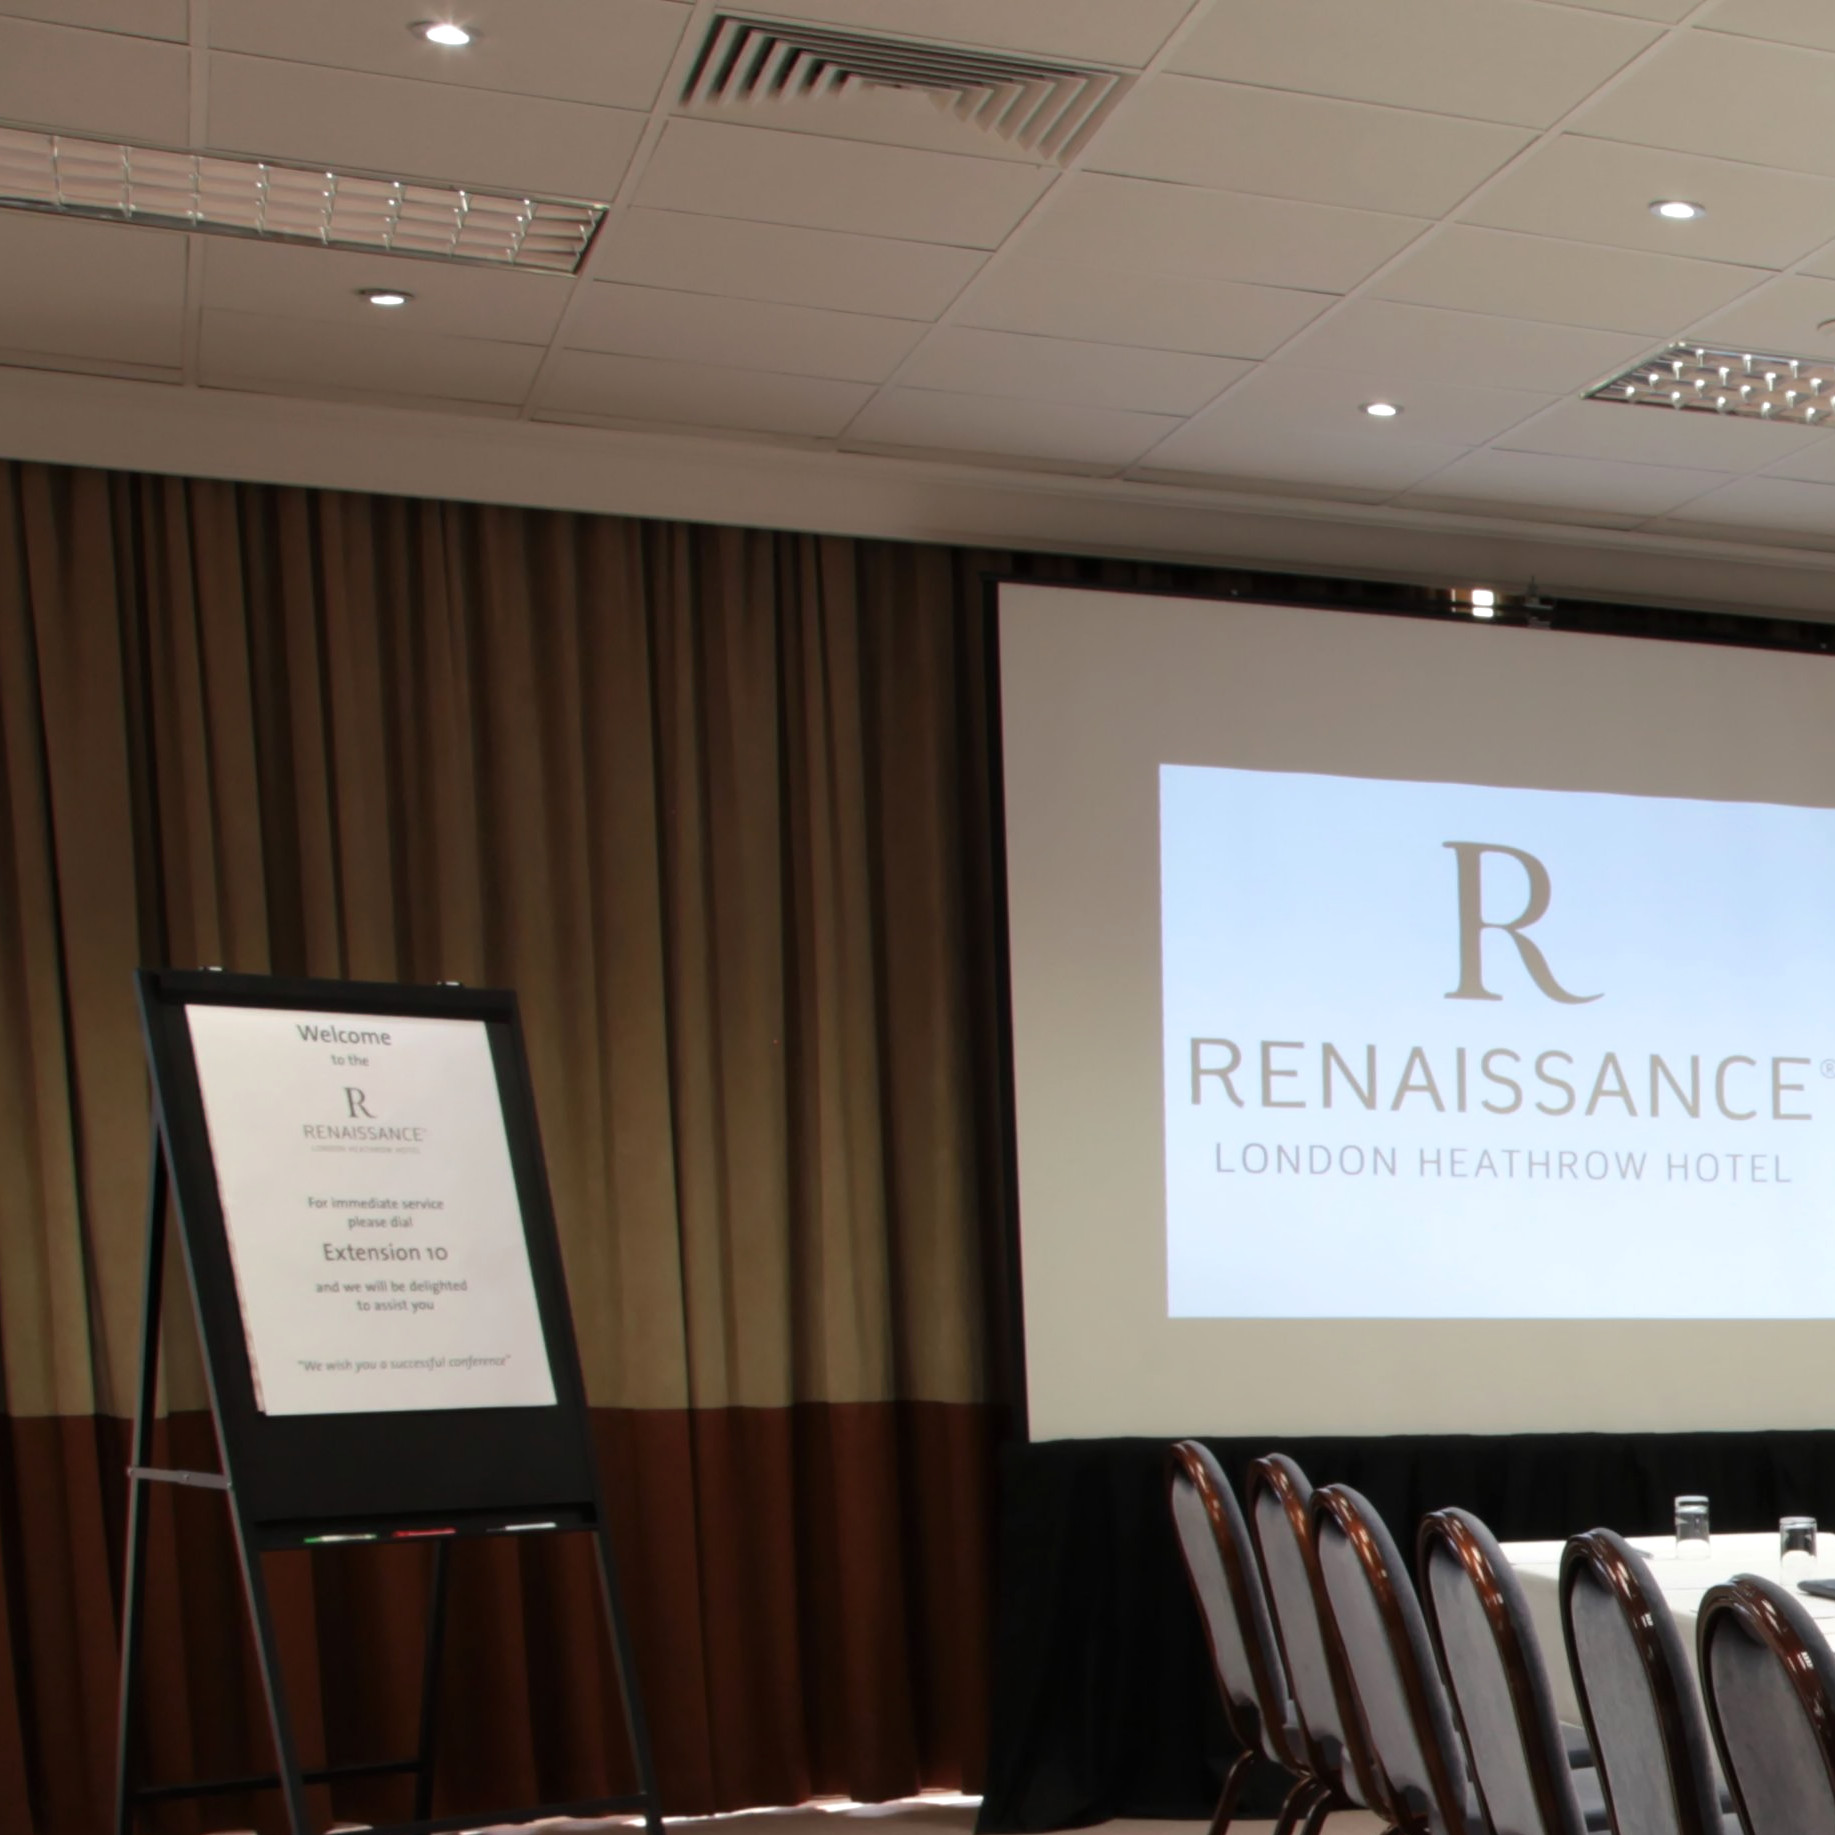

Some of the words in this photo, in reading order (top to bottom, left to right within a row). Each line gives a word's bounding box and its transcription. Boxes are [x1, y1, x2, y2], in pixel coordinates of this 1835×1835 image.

[1441, 839, 1606, 1005] R
[296, 1024, 392, 1047] Welcome
[331, 1054, 346, 1067] to
[347, 1054, 370, 1068] the
[343, 1086, 377, 1119] R
[1214, 1142, 1398, 1177] LONDON
[1419, 1147, 1648, 1183] HEATHROW
[1666, 1152, 1793, 1184] HOTEL
[307, 1196, 328, 1210] For
[331, 1196, 399, 1211] immediate
[401, 1197, 445, 1211] service
[347, 1215, 388, 1230] please
[391, 1215, 413, 1229] dial
[323, 1244, 421, 1262] Extension
[427, 1247, 448, 1262] 10
[315, 1280, 340, 1293] and
[343, 1283, 363, 1294] we
[364, 1279, 388, 1293] will
[391, 1279, 406, 1293] be
[409, 1279, 468, 1296] delighted
[357, 1299, 371, 1312] to
[374, 1299, 408, 1312] assist
[411, 1301, 435, 1315] you
[325, 1357, 352, 1372] wish
[354, 1359, 378, 1374] you
[390, 1356, 446, 1372] successful
